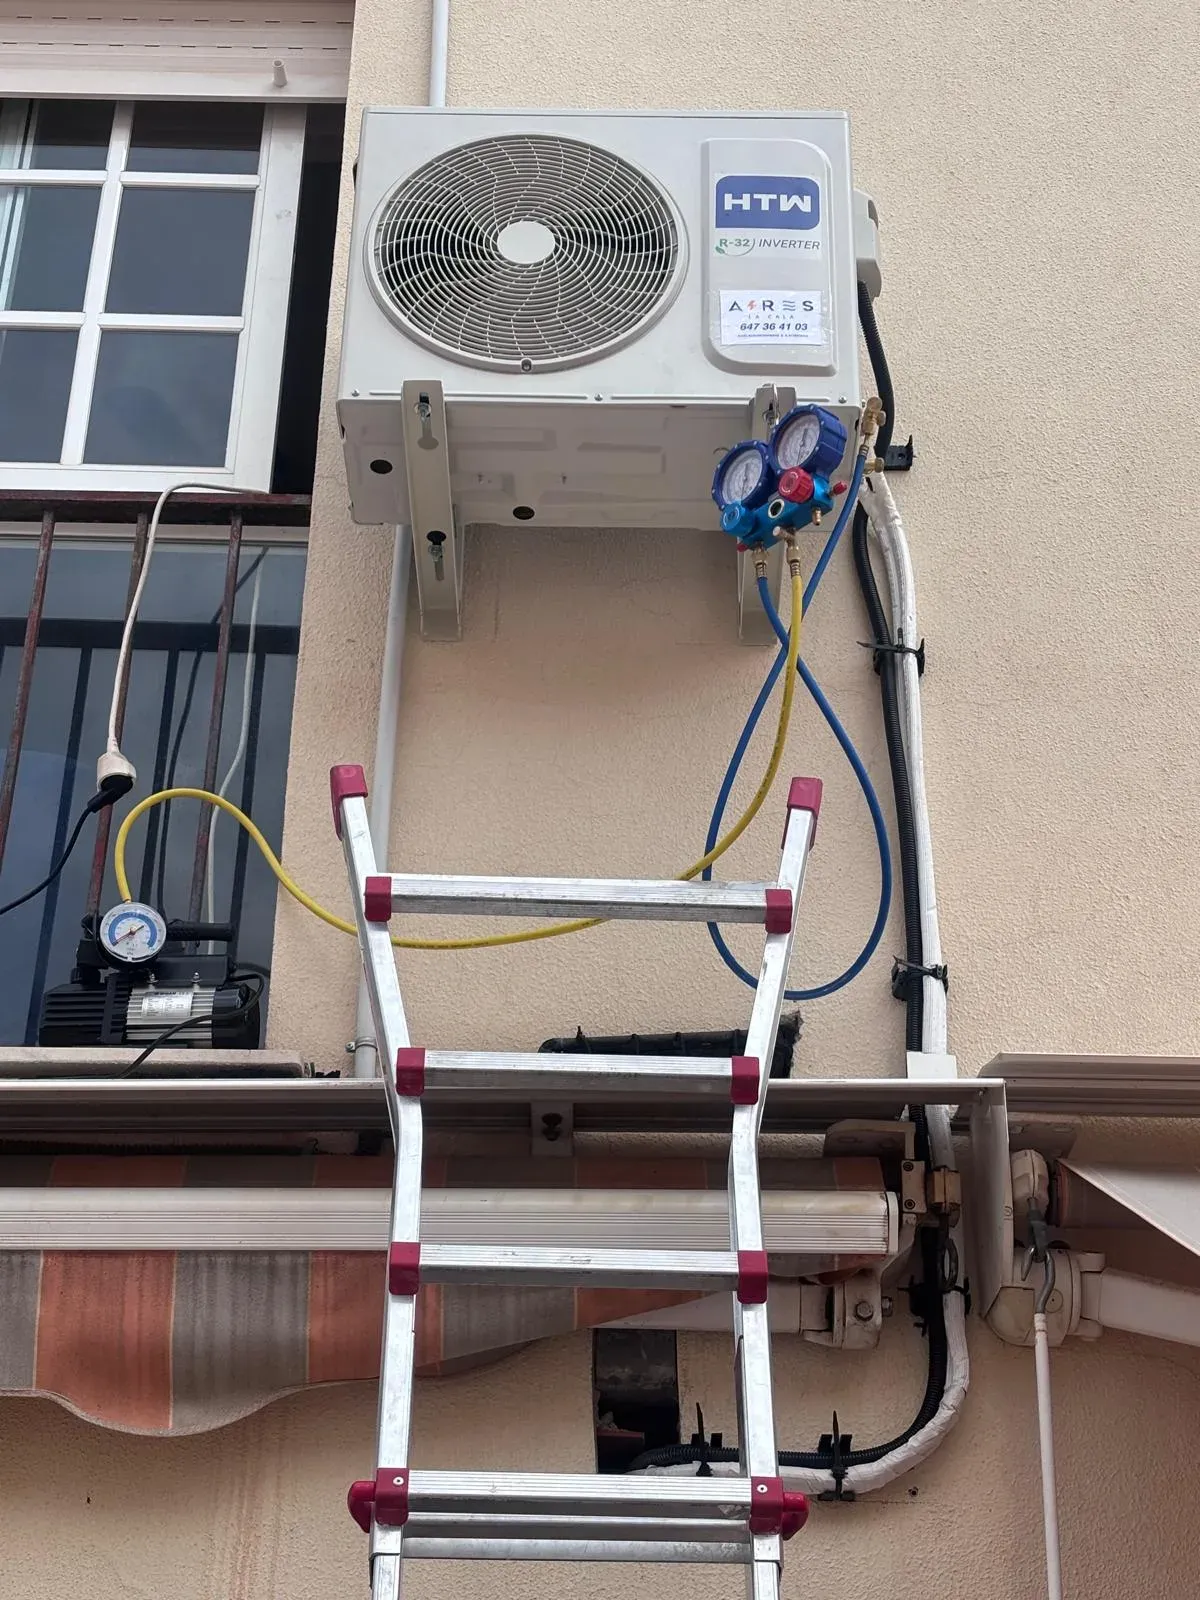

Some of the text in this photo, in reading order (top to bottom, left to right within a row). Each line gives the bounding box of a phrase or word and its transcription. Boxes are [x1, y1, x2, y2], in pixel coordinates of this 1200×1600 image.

[724, 193, 812, 213] HTW
[719, 238, 821, 250] R-32 INVERTER
[740, 322, 808, 331] 647 36 41 03
